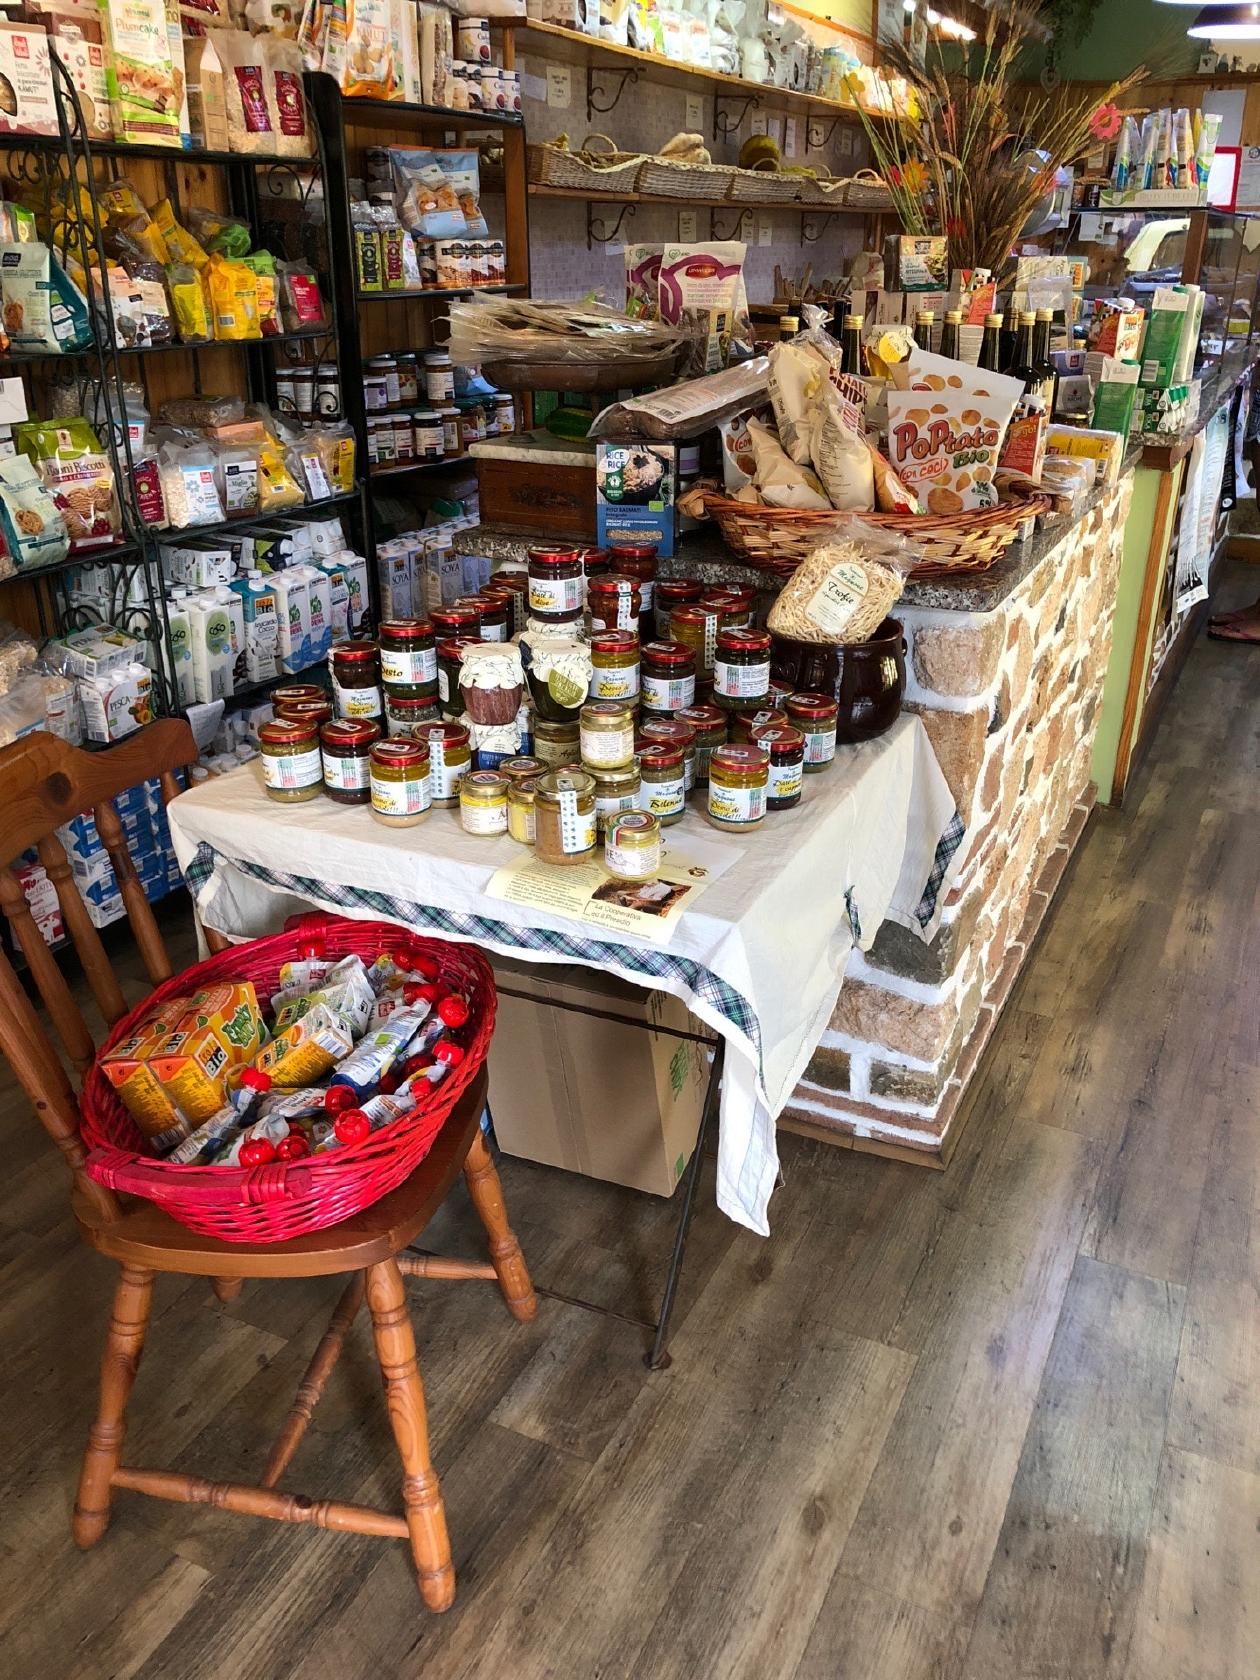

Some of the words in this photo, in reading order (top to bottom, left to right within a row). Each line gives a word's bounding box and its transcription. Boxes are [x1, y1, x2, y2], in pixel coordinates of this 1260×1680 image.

[606, 452, 624, 460] RICE
[608, 461, 626, 469] RICE
[441, 562, 460, 576] SOYA
[392, 574, 410, 586] SOYA
[110, 696, 131, 712] PESCA
